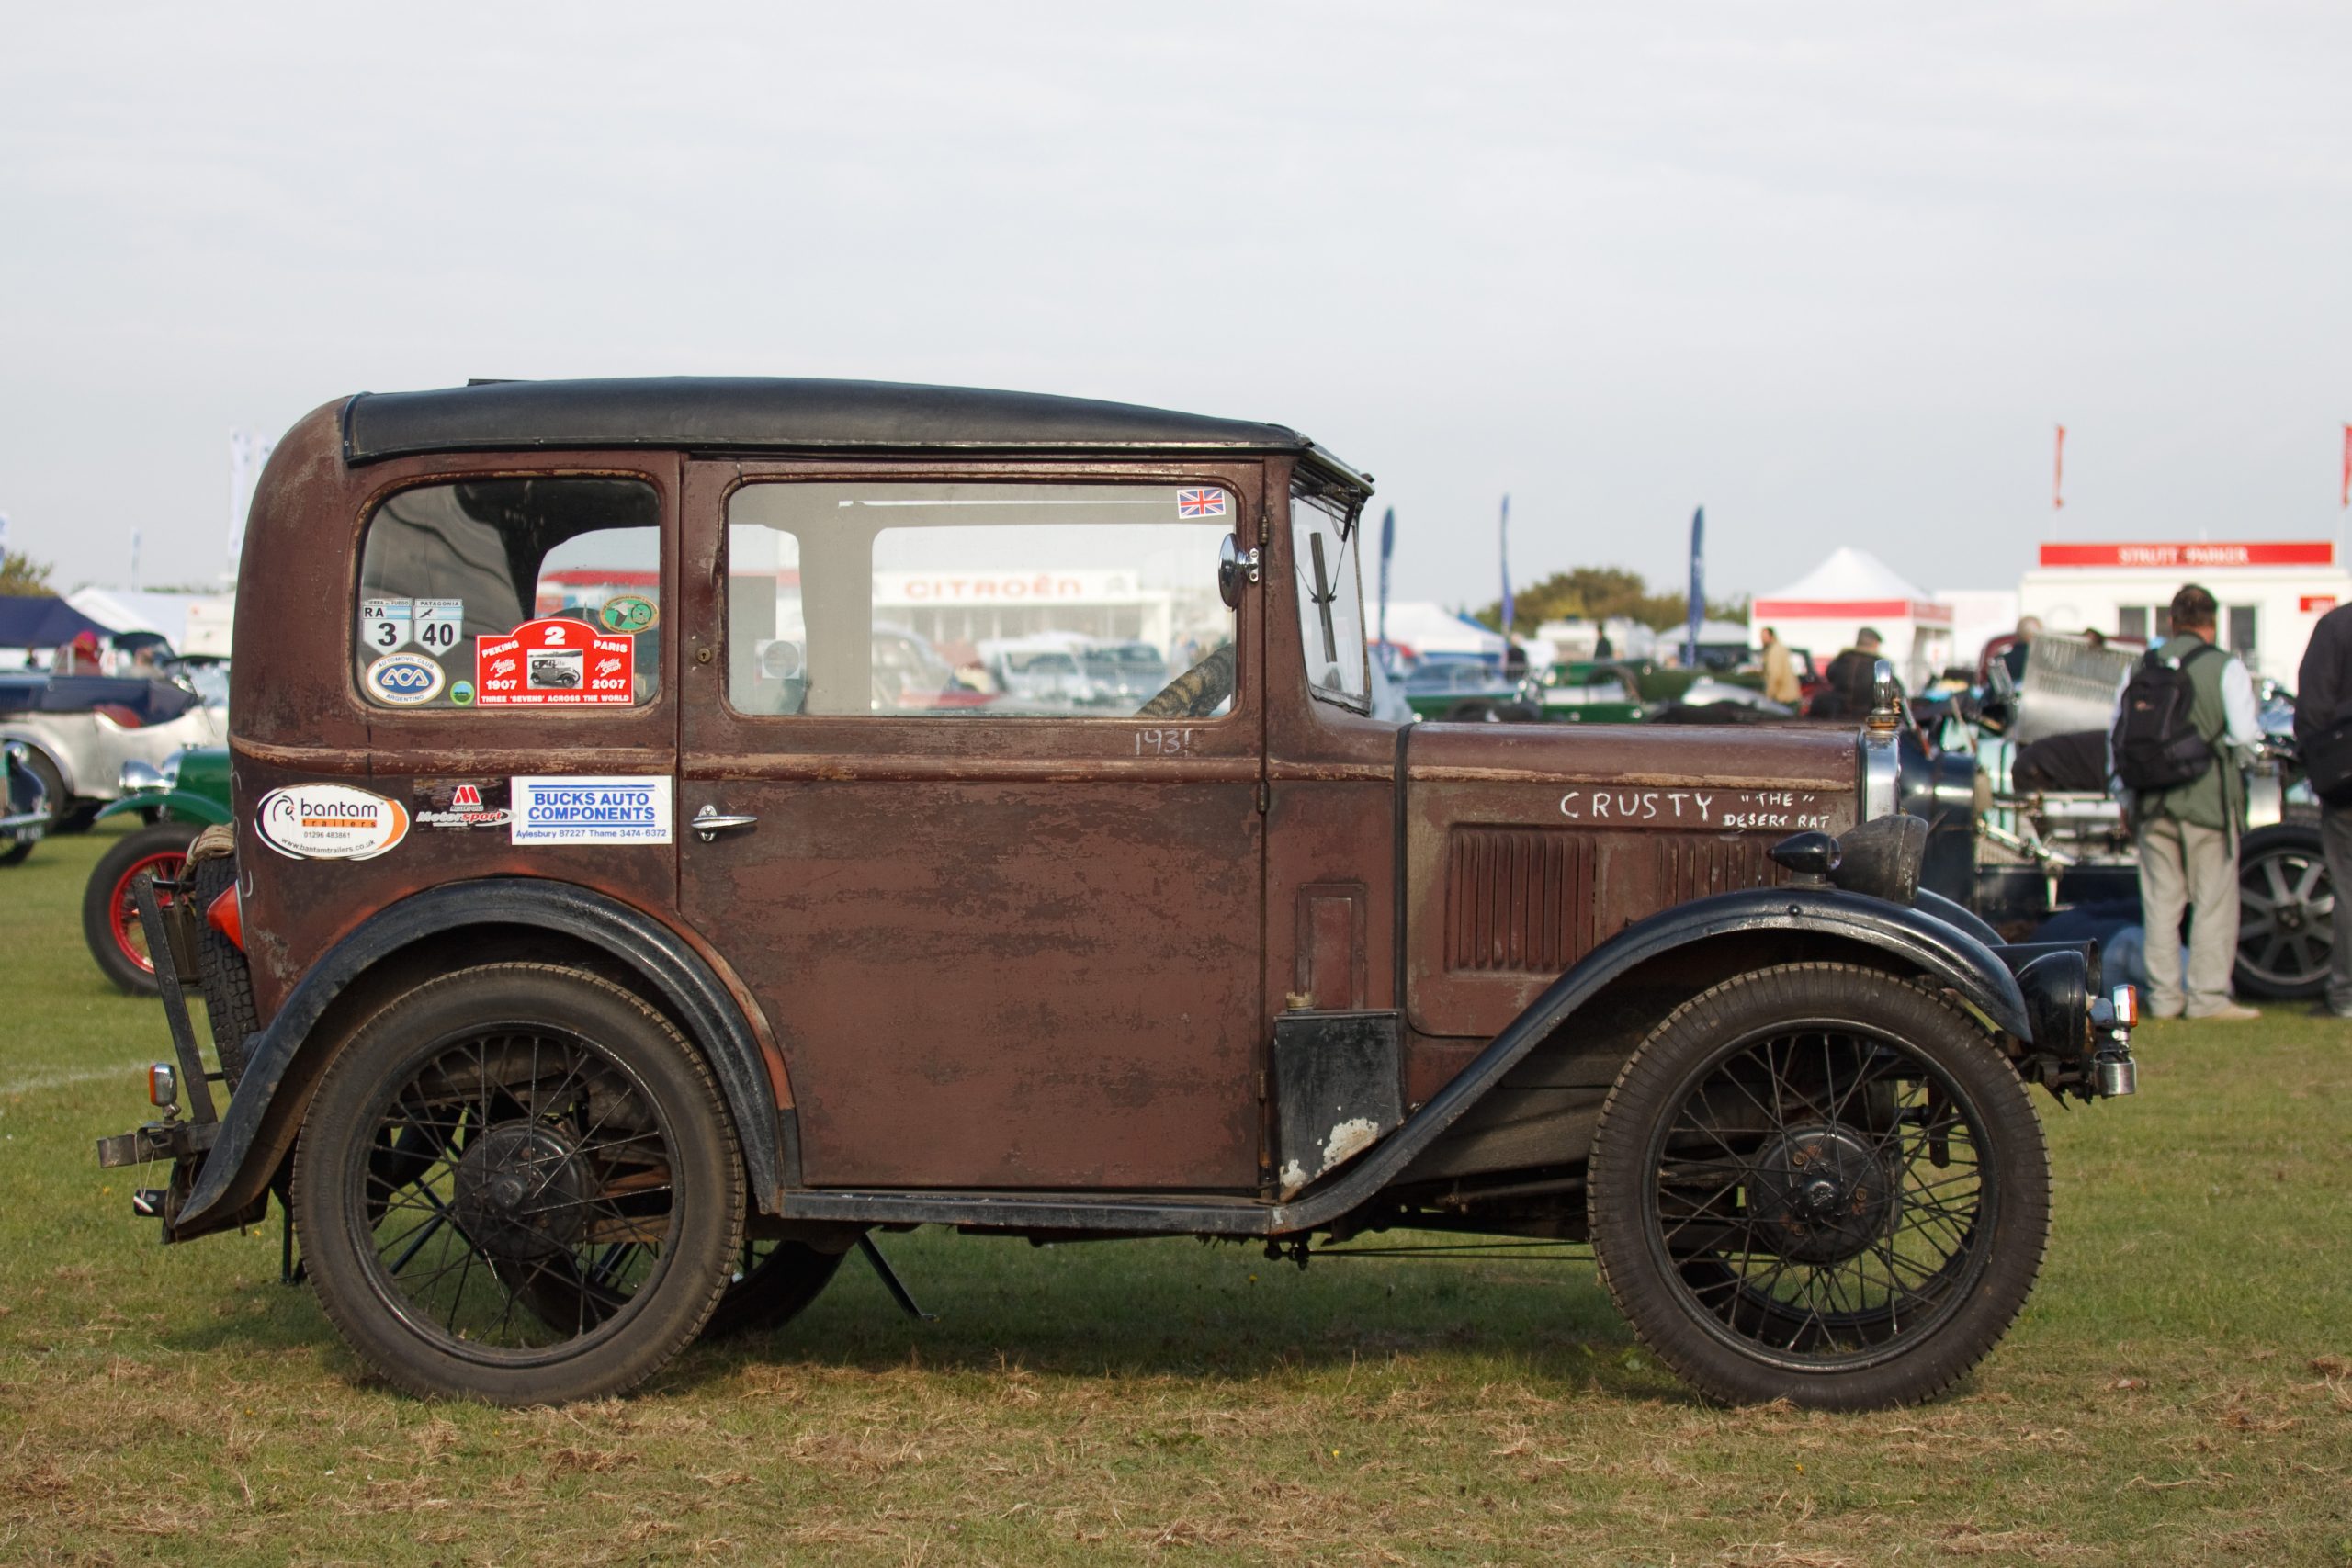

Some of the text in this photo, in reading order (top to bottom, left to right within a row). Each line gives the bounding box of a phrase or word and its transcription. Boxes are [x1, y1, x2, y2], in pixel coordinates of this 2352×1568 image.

[377, 622, 397, 647] 3
[422, 623, 454, 647] 40
[544, 626, 566, 645] 2
[481, 640, 520, 658] PEKING
[593, 640, 628, 653] PARIS
[378, 656, 435, 670] AUTOMOVIL CLUB
[486, 679, 517, 690] 1907
[592, 679, 626, 690] 2007
[385, 694, 424, 702] ARGENTINO
[534, 793, 649, 806] BUCKS AUTO
[1560, 791, 1713, 821] CRUSTY
[300, 798, 378, 818] bantam
[528, 807, 655, 820] COMPONENTS
[302, 819, 377, 828] trailers
[416, 811, 502, 823] Motorsport
[1723, 814, 1830, 829] DESERT RAT
[515, 829, 557, 839] Aylesbury
[281, 837, 376, 854] www.bantamtrailers.co.uk
